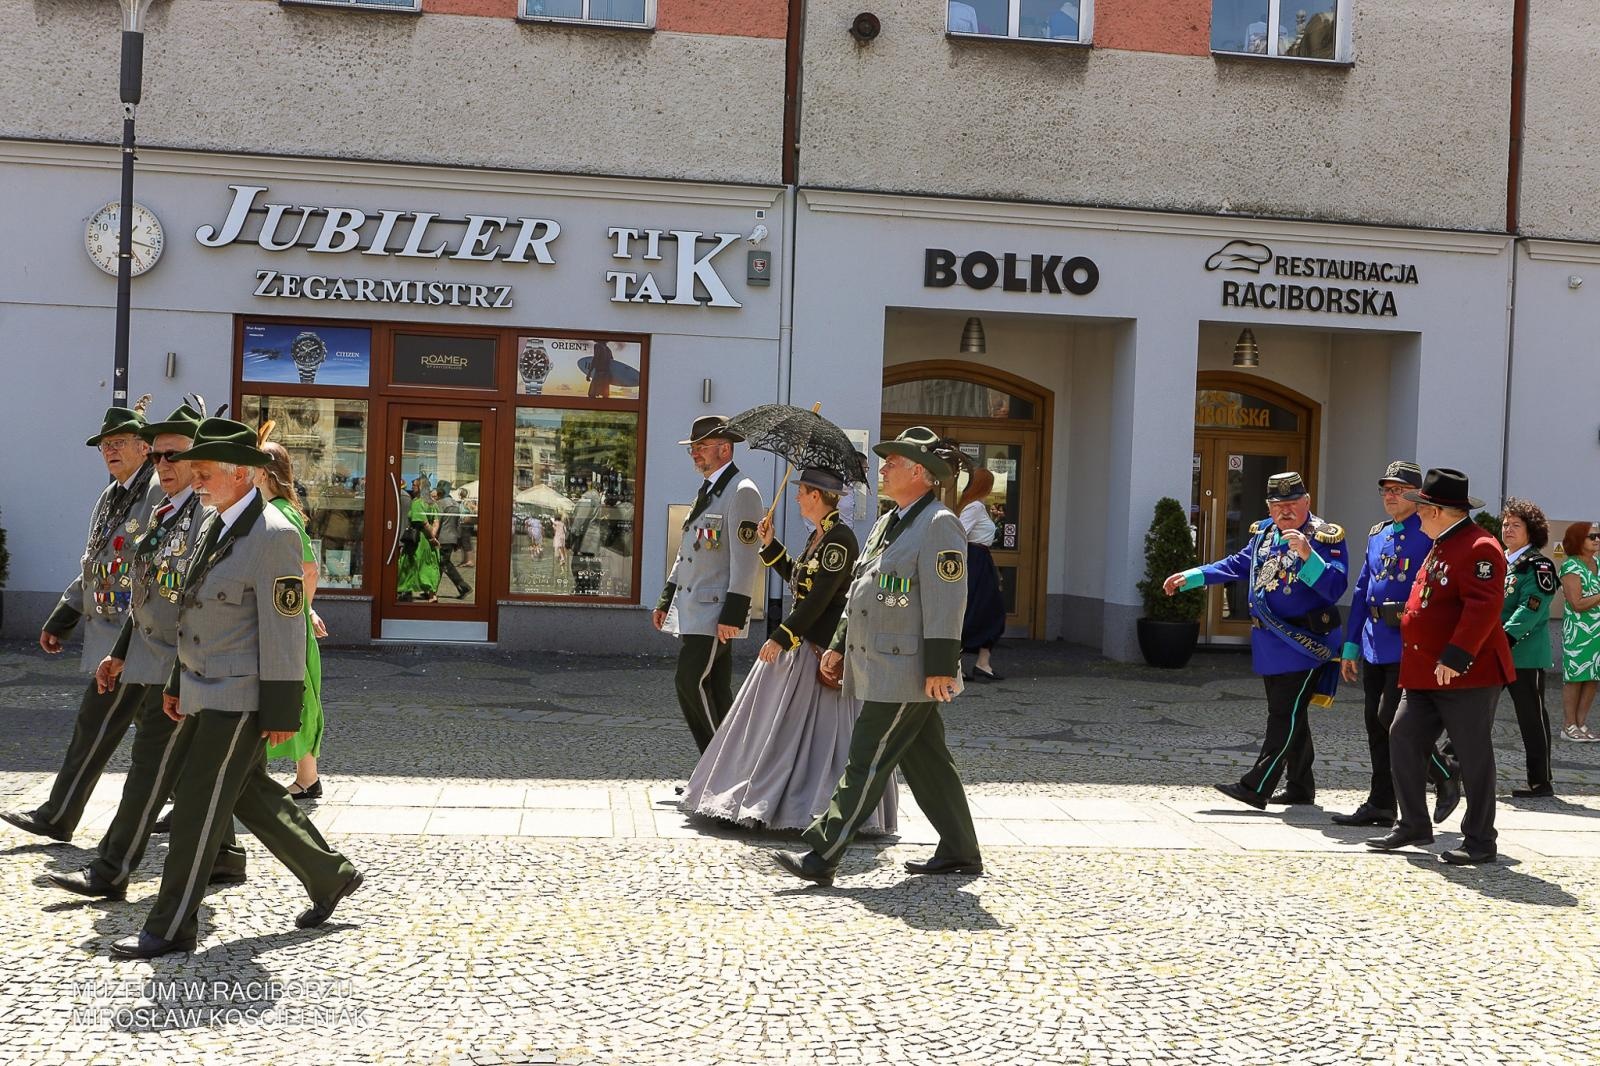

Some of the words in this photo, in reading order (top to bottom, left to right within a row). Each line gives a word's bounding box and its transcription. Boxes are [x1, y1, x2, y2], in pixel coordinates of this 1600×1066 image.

[108, 213, 116, 221] 11
[98, 223, 109, 231] 10
[195, 184, 562, 264] JUBILER
[146, 226, 152, 235] 2
[93, 233, 99, 242] 9
[150, 237, 156, 246] 3
[96, 244, 103, 253] 8
[145, 248, 151, 256] 4
[106, 256, 112, 264] 7
[924, 248, 1099, 295] BOLKO
[1274, 255, 1419, 286] RESTAURACJA
[253, 269, 513, 309] ZEGARMISTRZ
[1222, 279, 1399, 317] RACIBORSKA
[551, 341, 590, 351] ORIENT
[335, 351, 361, 359] CITIZEN
[420, 354, 469, 368] ROAMER
